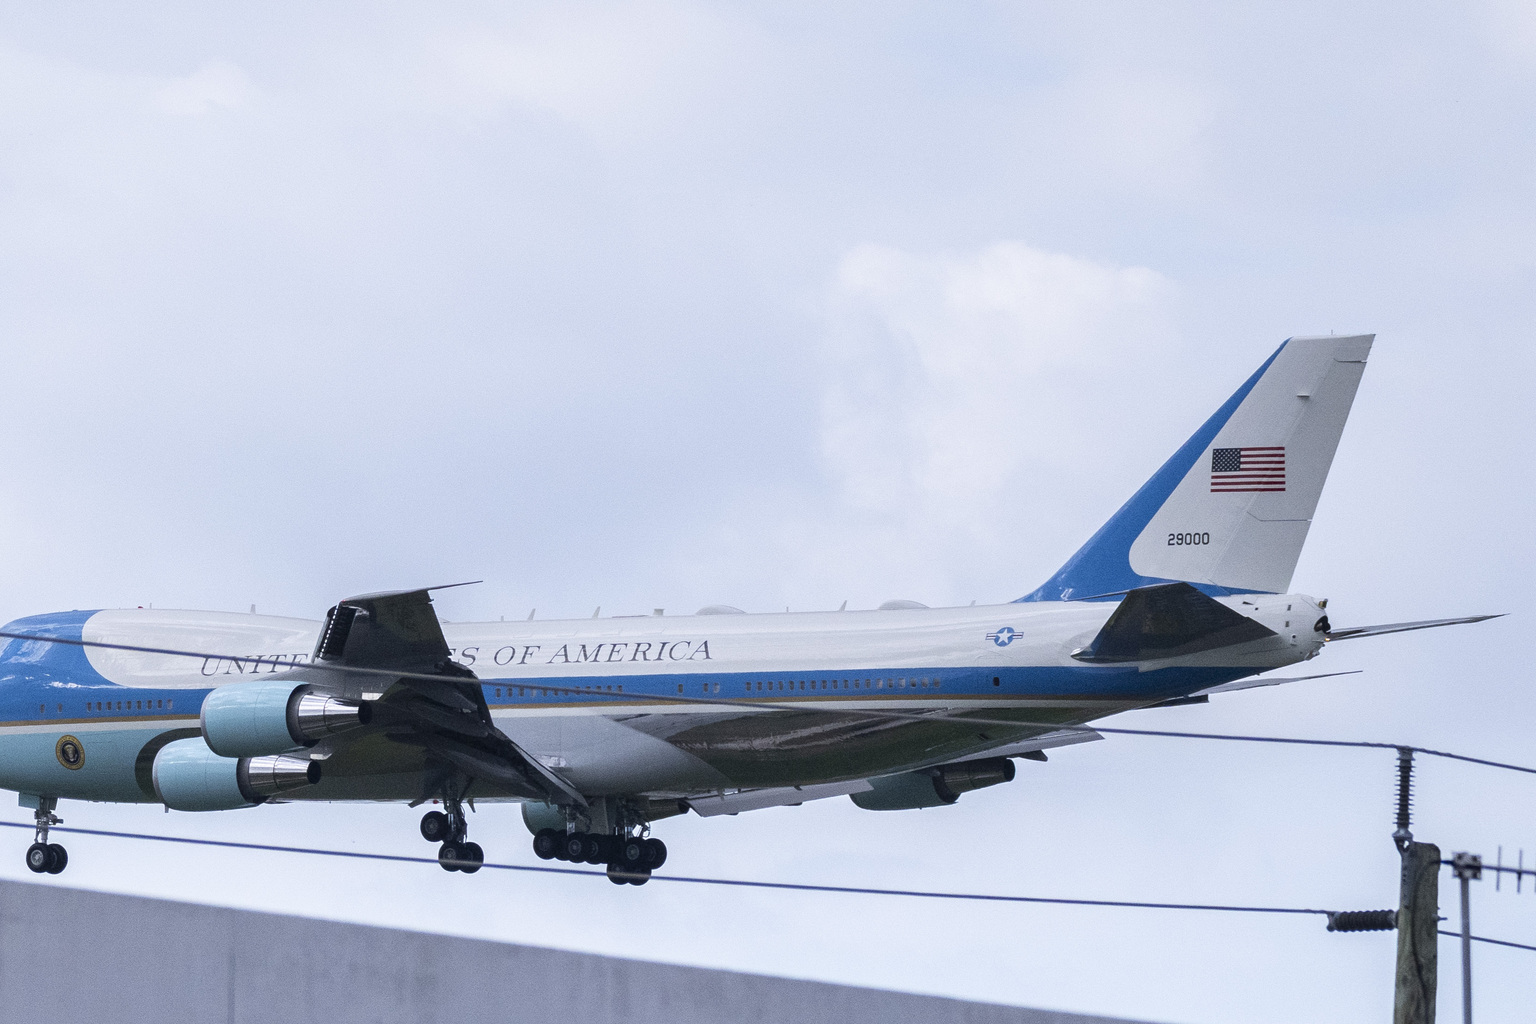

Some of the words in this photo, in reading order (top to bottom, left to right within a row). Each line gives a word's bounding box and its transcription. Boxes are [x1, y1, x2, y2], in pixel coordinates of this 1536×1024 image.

[1167, 532, 1210, 546] 29000
[200, 653, 310, 677] UNITE
[494, 645, 541, 665] OF
[546, 640, 713, 664] AMERICA
